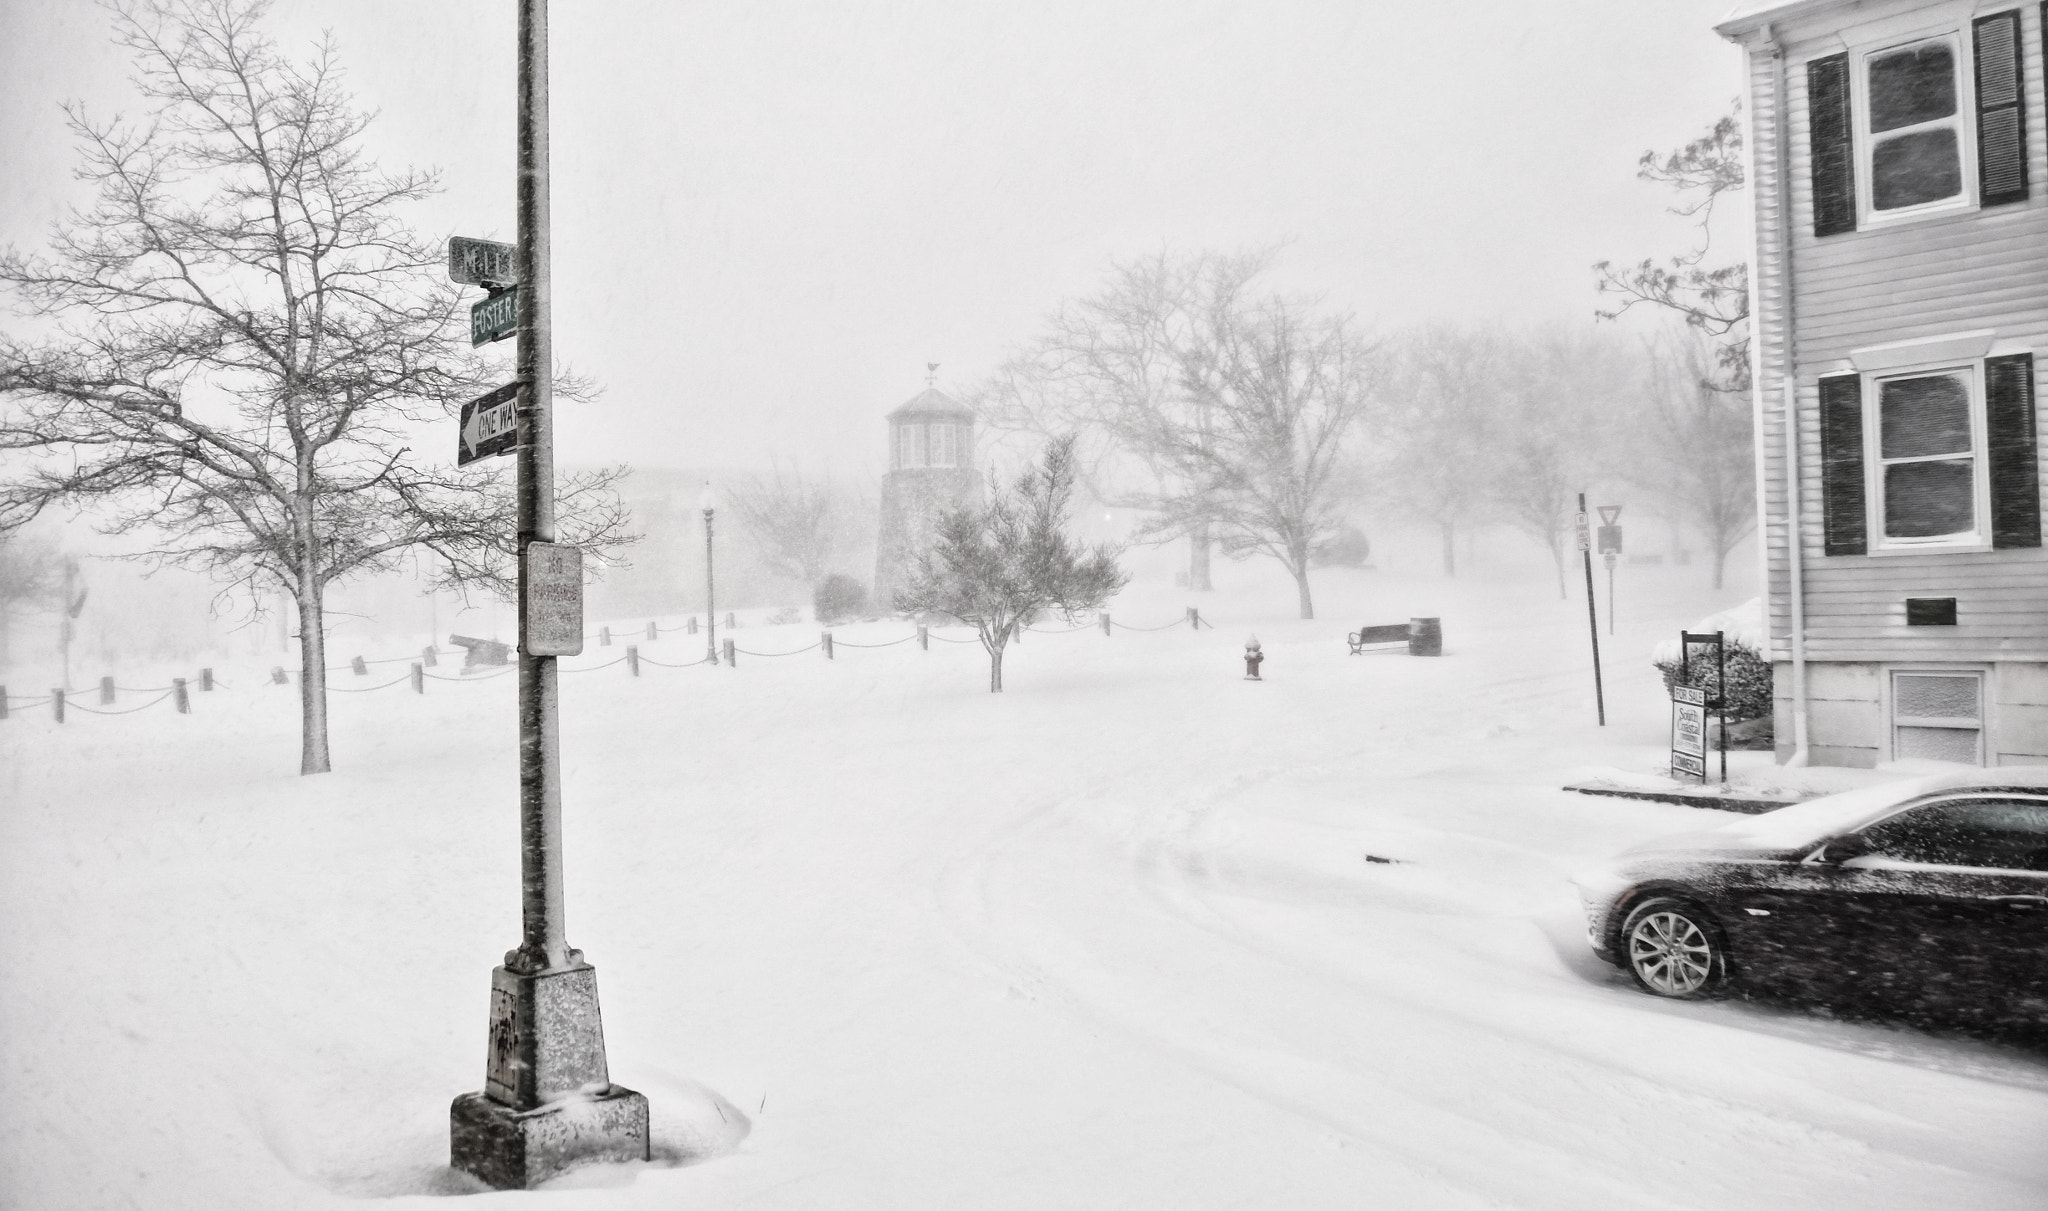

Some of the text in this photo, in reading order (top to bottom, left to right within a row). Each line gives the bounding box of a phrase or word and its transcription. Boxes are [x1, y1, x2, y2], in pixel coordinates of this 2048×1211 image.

[473, 297, 511, 338] FOSTER
[479, 402, 518, 439] ONE WAY
[1675, 687, 1703, 704] FOR SALE
[1679, 707, 1699, 722] South
[1674, 754, 1702, 775] COMMERCIAL
